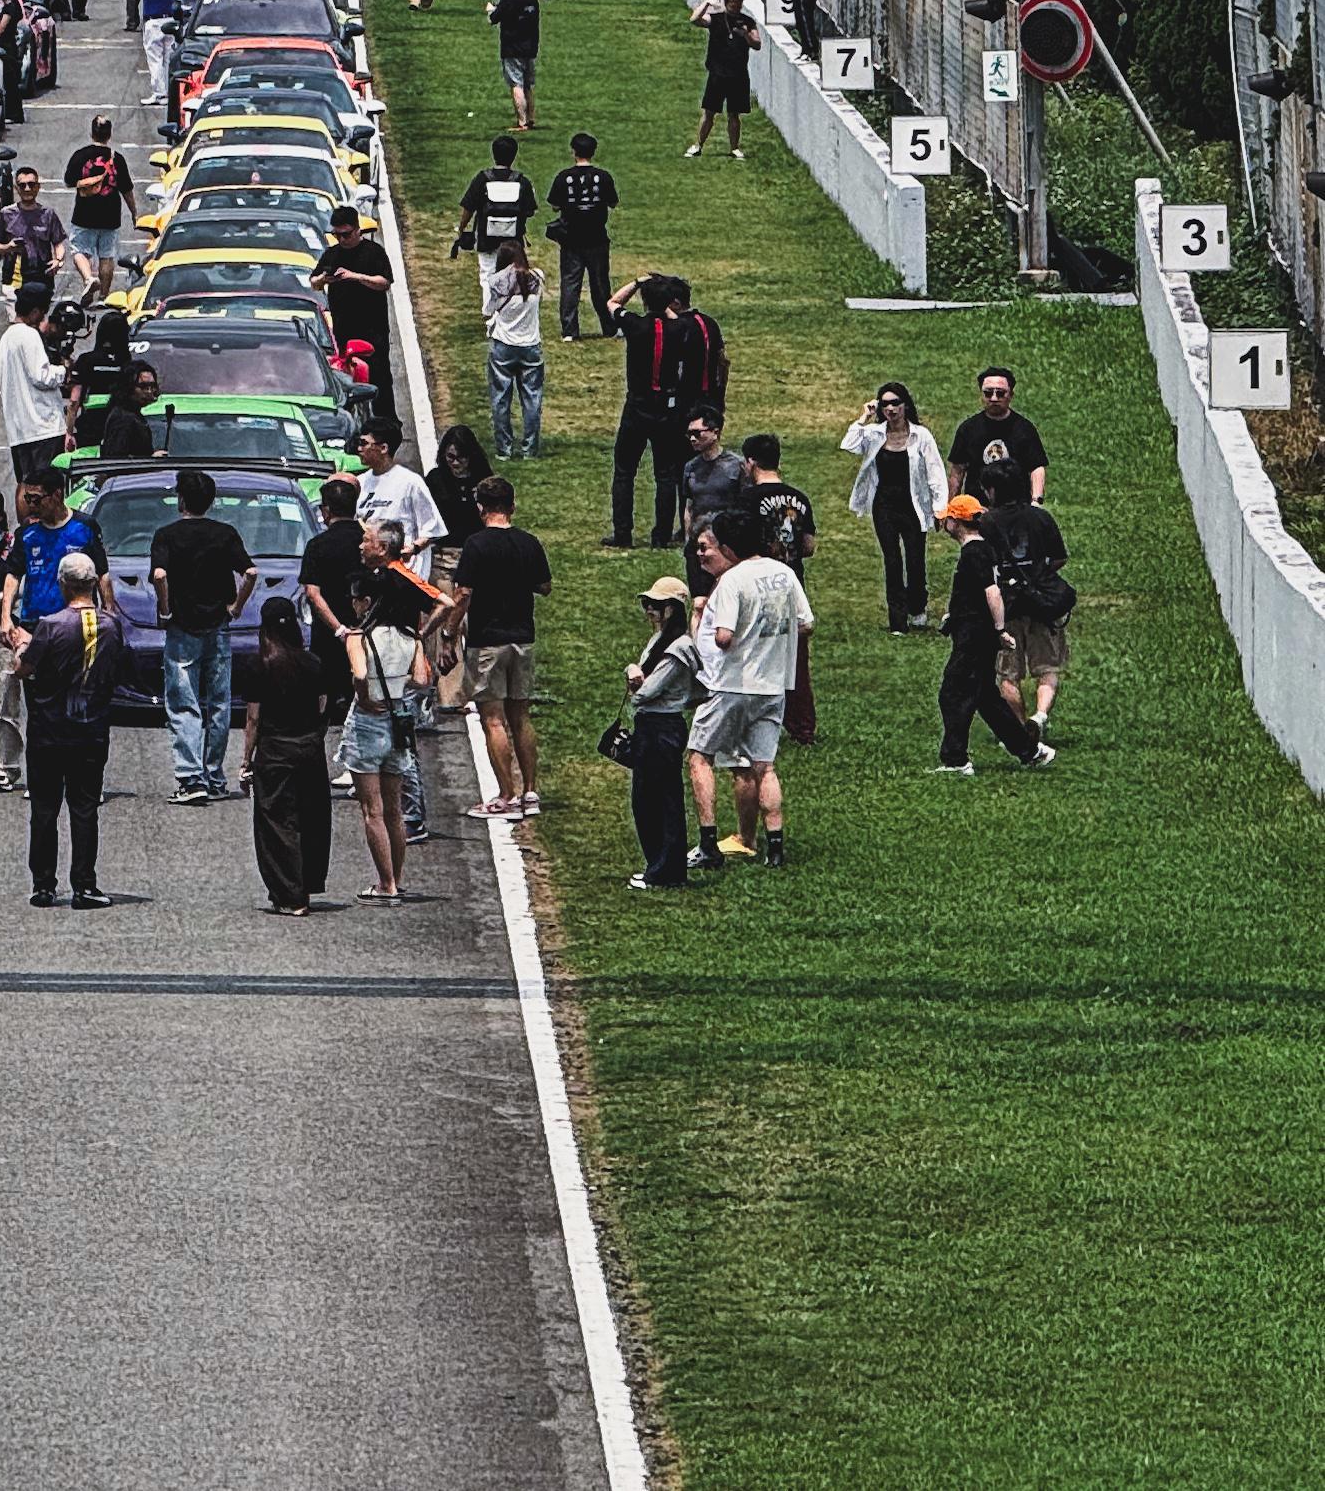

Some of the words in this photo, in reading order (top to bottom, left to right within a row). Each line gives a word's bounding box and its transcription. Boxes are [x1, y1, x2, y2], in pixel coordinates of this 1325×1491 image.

[836, 48, 857, 77] 7
[909, 129, 932, 161] 5
[1182, 218, 1208, 256] 3
[1239, 345, 1260, 389] 1
